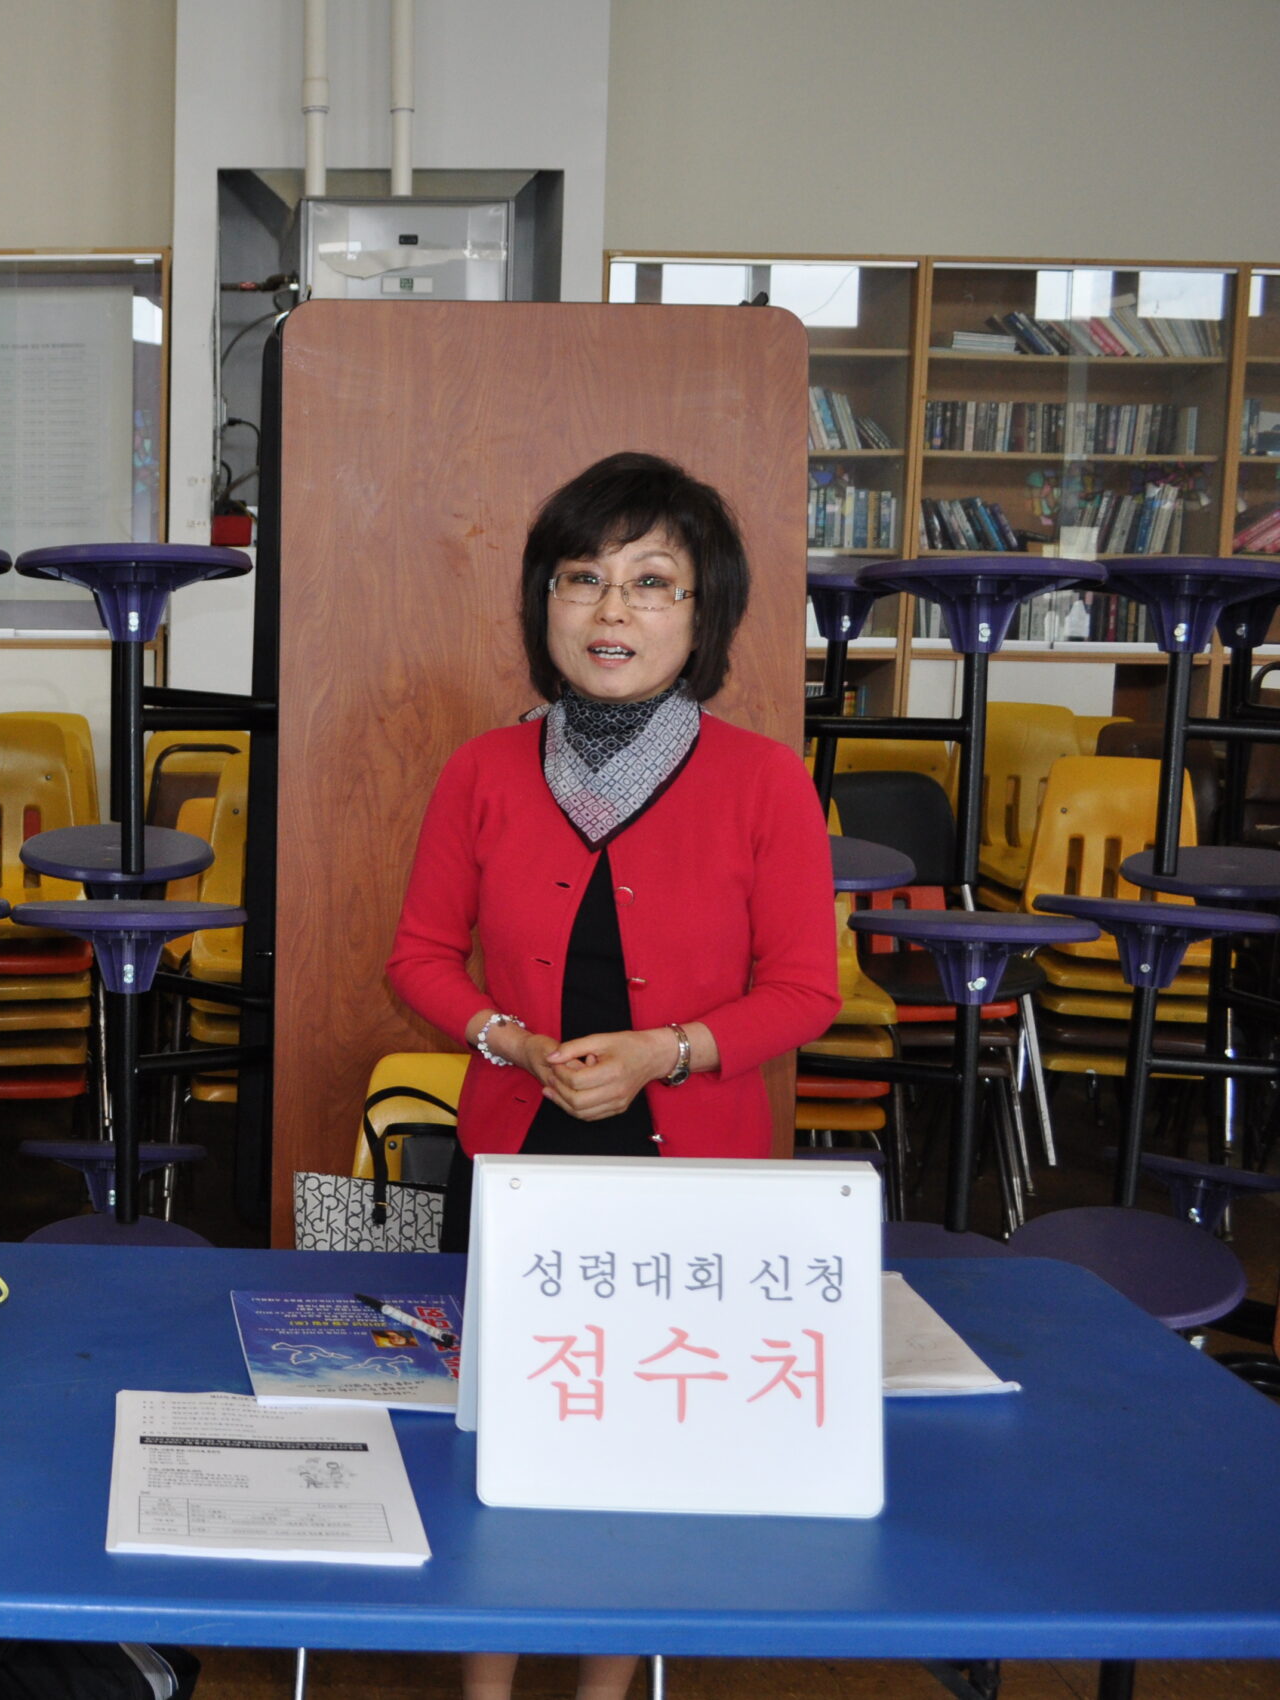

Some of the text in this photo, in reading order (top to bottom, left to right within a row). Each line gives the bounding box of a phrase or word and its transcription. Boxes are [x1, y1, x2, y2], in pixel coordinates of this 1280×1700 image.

[522, 1249, 845, 1304] 성령대회 신청
[525, 1323, 825, 1429] 접수처
